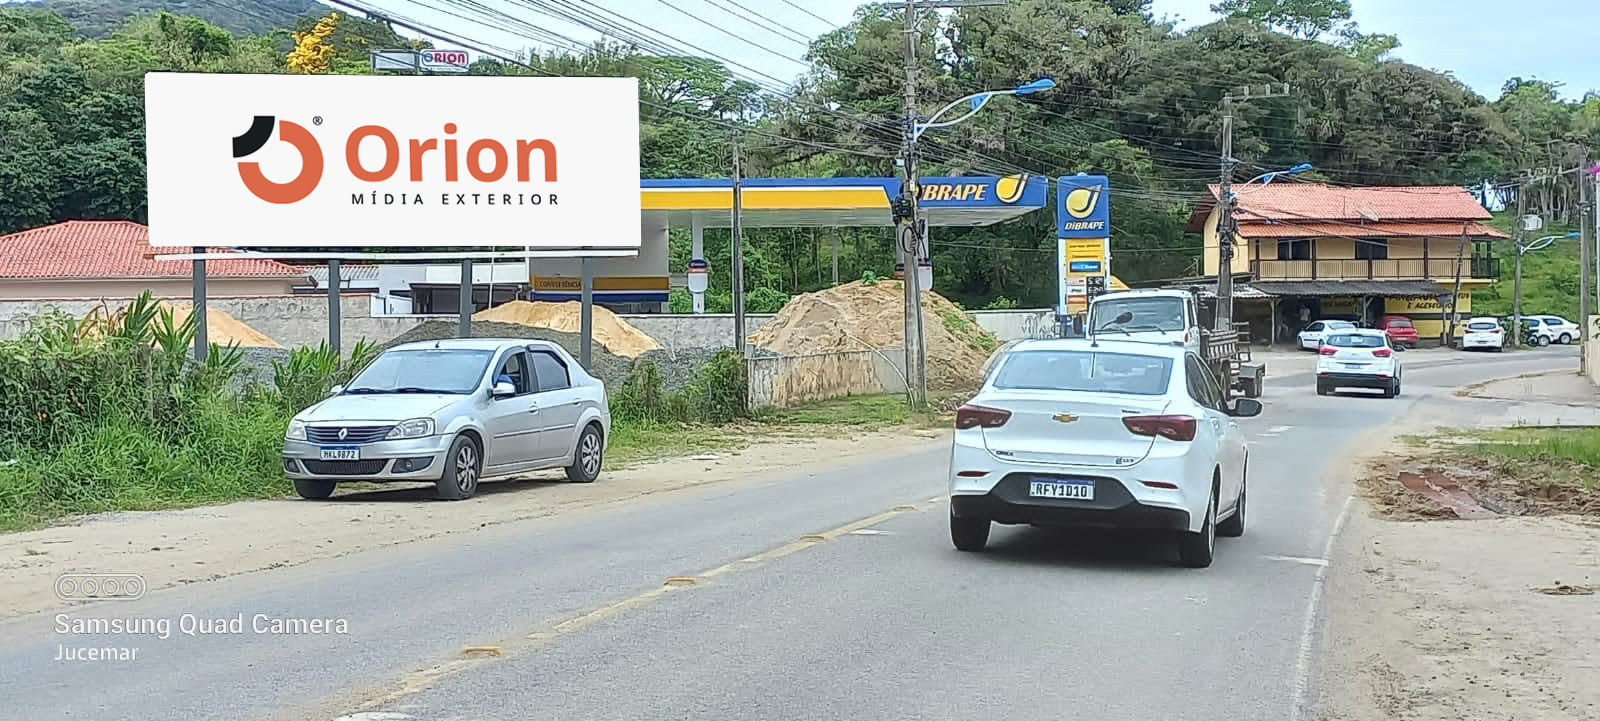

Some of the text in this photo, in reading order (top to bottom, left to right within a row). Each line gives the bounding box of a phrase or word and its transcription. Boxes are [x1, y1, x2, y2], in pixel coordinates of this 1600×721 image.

[346, 123, 557, 182] Orion
[352, 191, 560, 205] MÍDIA EXTERIOR
